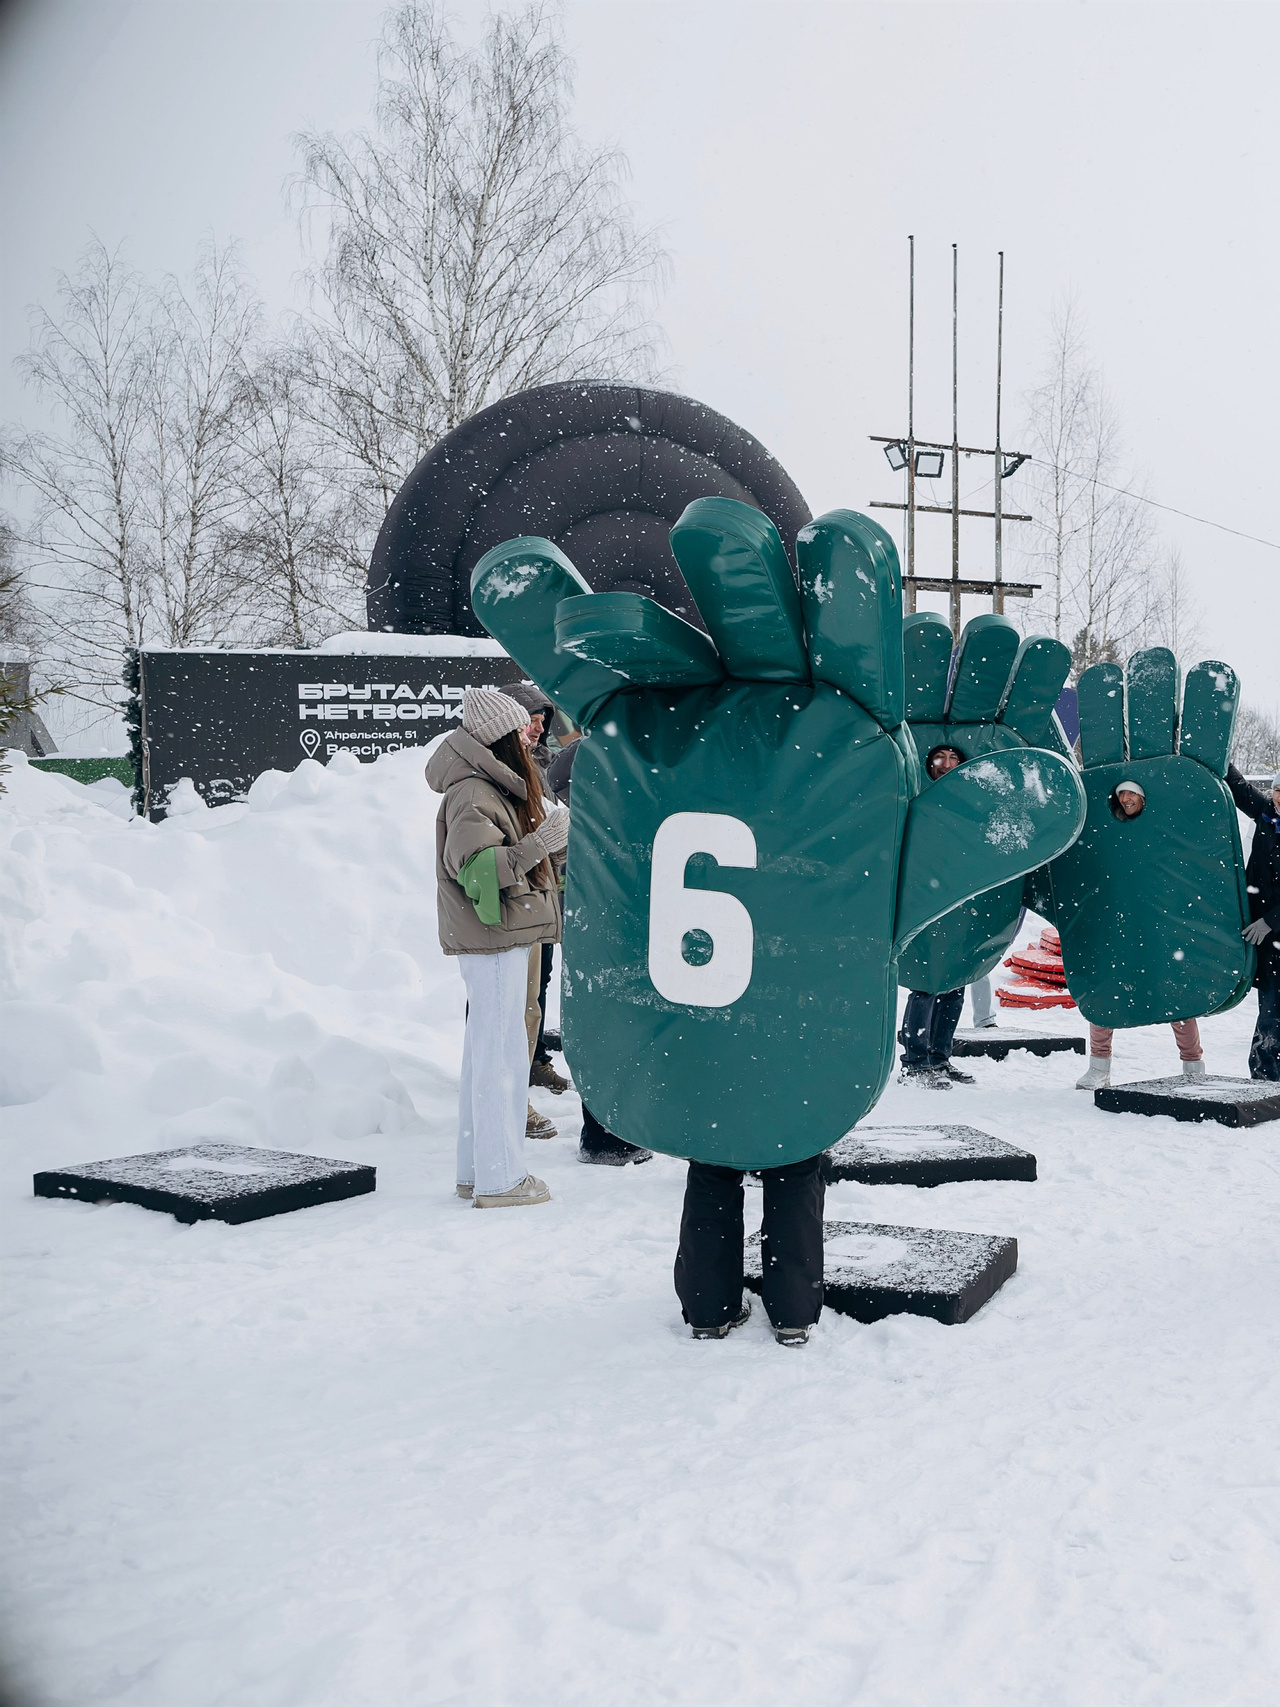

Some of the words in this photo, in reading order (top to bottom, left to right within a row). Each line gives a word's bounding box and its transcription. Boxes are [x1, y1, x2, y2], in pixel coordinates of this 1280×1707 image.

[298, 680, 540, 700] БРУТАЛЬ
[325, 731, 402, 741] Апрельская,
[404, 730, 417, 739] 51
[648, 811, 757, 1008] 6
